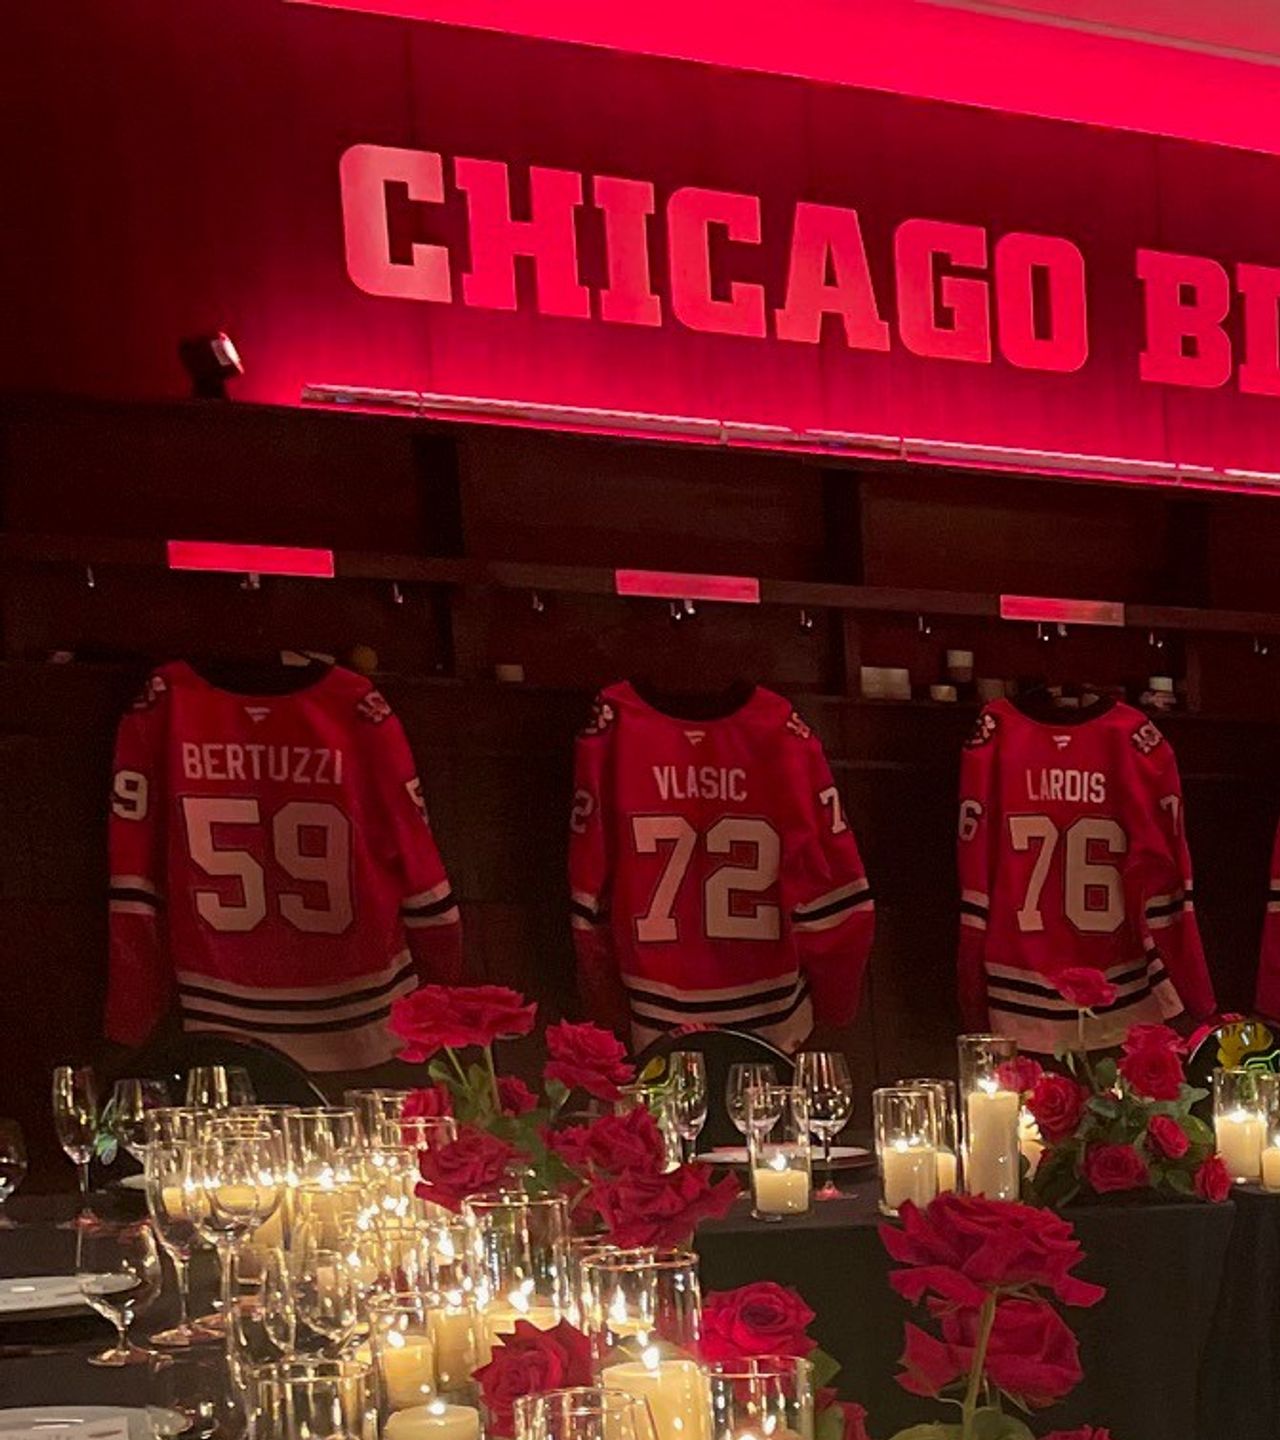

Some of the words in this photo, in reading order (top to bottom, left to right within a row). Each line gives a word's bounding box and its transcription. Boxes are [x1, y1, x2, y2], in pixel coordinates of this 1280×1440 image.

[340, 144, 1089, 373] CHICAGO
[183, 743, 342, 784] BERTUZZI
[653, 765, 748, 800] VLASIC
[1026, 768, 1106, 803] LARDIS
[183, 797, 354, 935] 59
[632, 816, 781, 942] 72
[1008, 816, 1128, 932] 76
